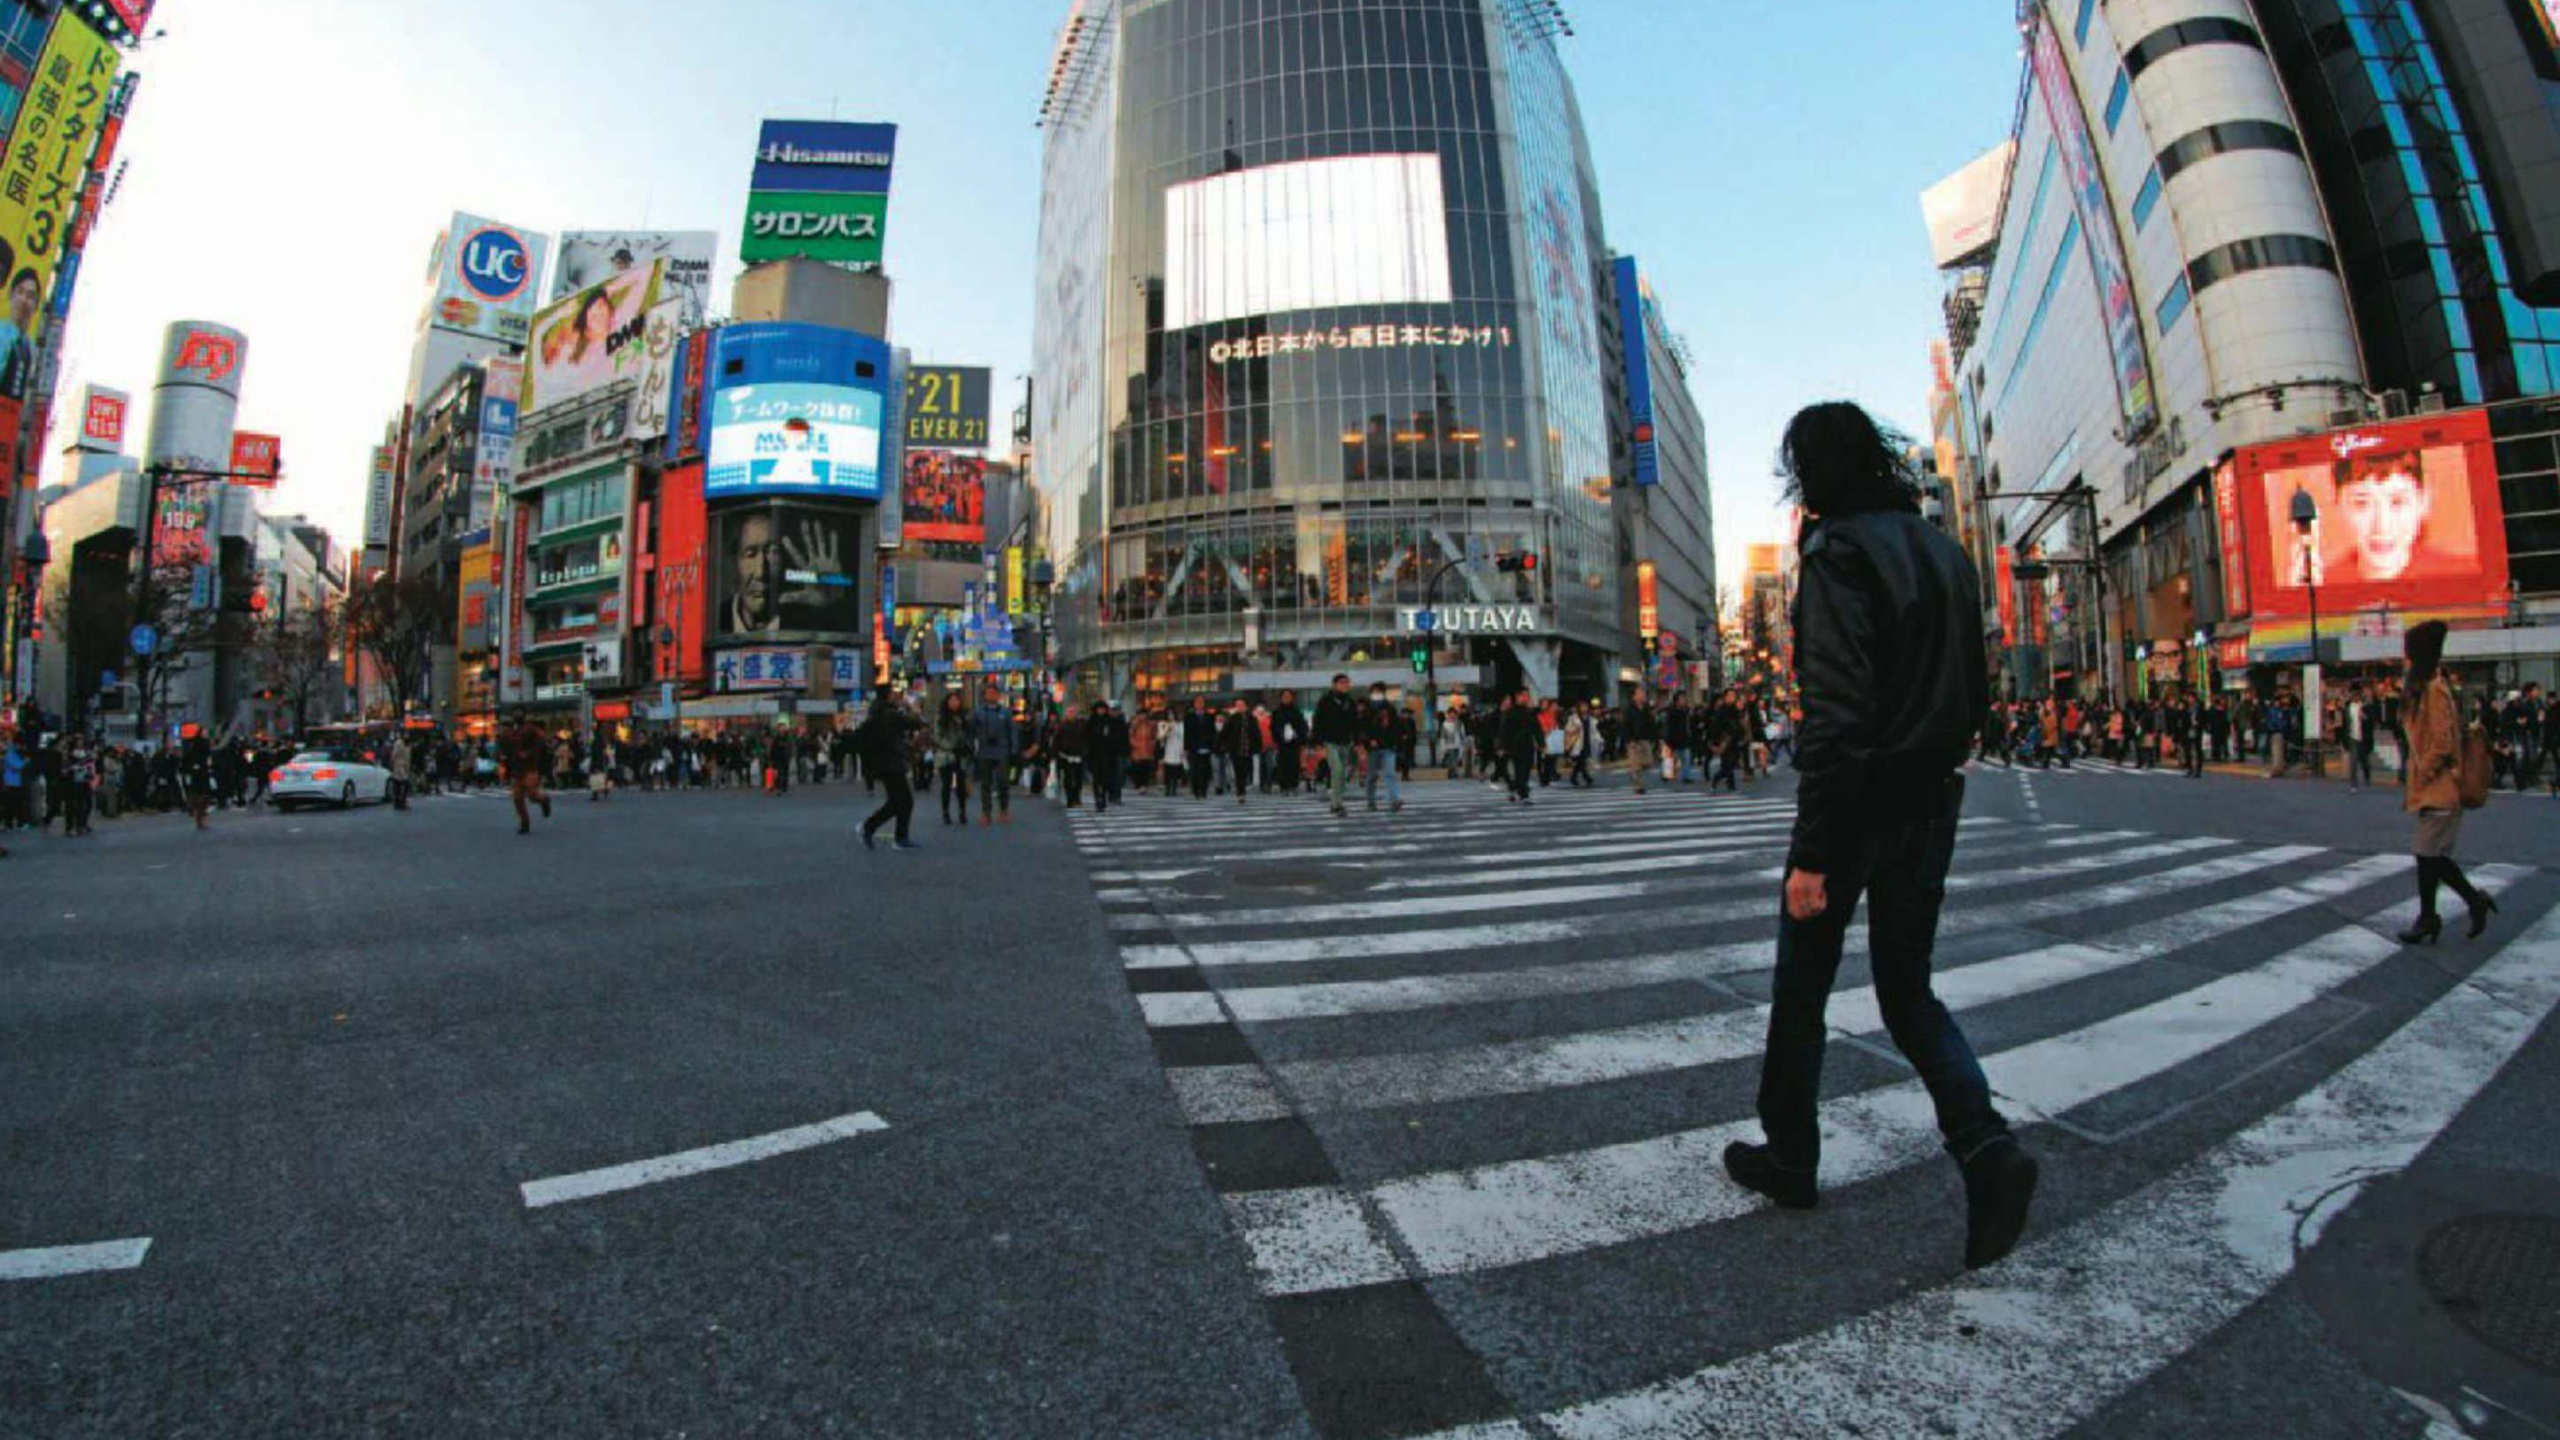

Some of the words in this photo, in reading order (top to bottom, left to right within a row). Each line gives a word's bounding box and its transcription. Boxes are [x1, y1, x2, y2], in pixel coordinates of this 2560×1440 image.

[761, 142, 889, 166] Hisamitsu
[469, 240, 527, 283] UC
[964, 418, 985, 441] 21
[717, 652, 855, 681] 大盛堂店
